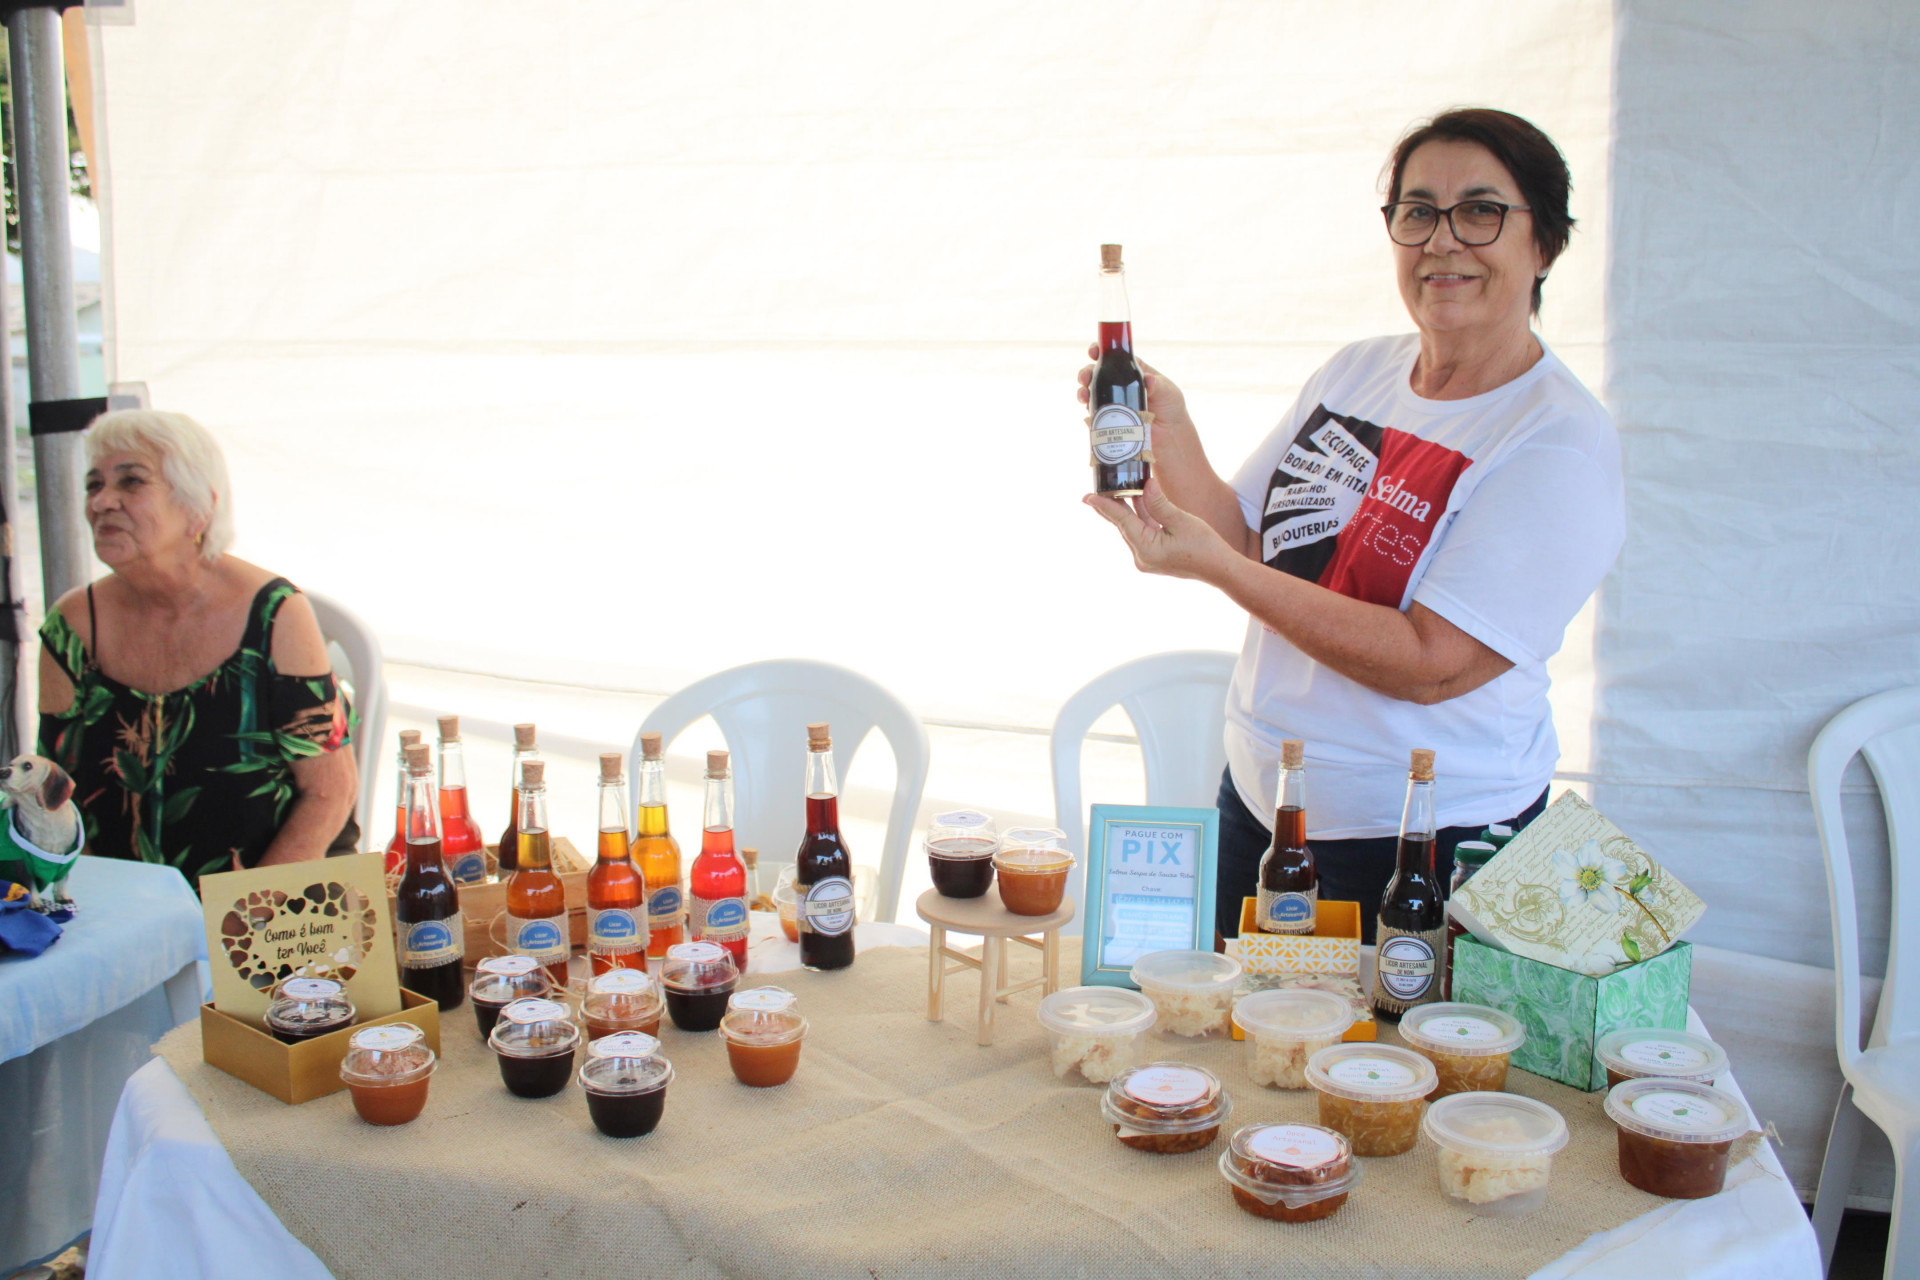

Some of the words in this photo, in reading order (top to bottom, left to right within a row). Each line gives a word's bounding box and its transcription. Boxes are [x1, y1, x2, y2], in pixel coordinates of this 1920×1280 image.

[1284, 452, 1326, 476] BORAD
[1324, 467, 1343, 483] EM
[1342, 475, 1368, 495] FITA
[1271, 497, 1336, 509] PERSONALIZADOS
[1368, 475, 1431, 523] Selma
[1272, 517, 1339, 549] BIOUTERIAS
[1125, 830, 1157, 838] PAGUE
[1122, 840, 1182, 865] PIX
[264, 929, 296, 943] Como
[300, 923, 306, 937] é
[309, 922, 334, 936] bom
[277, 947, 294, 960] ter
[297, 939, 326, 956] Você
[1272, 1136, 1316, 1144] Artesanal
